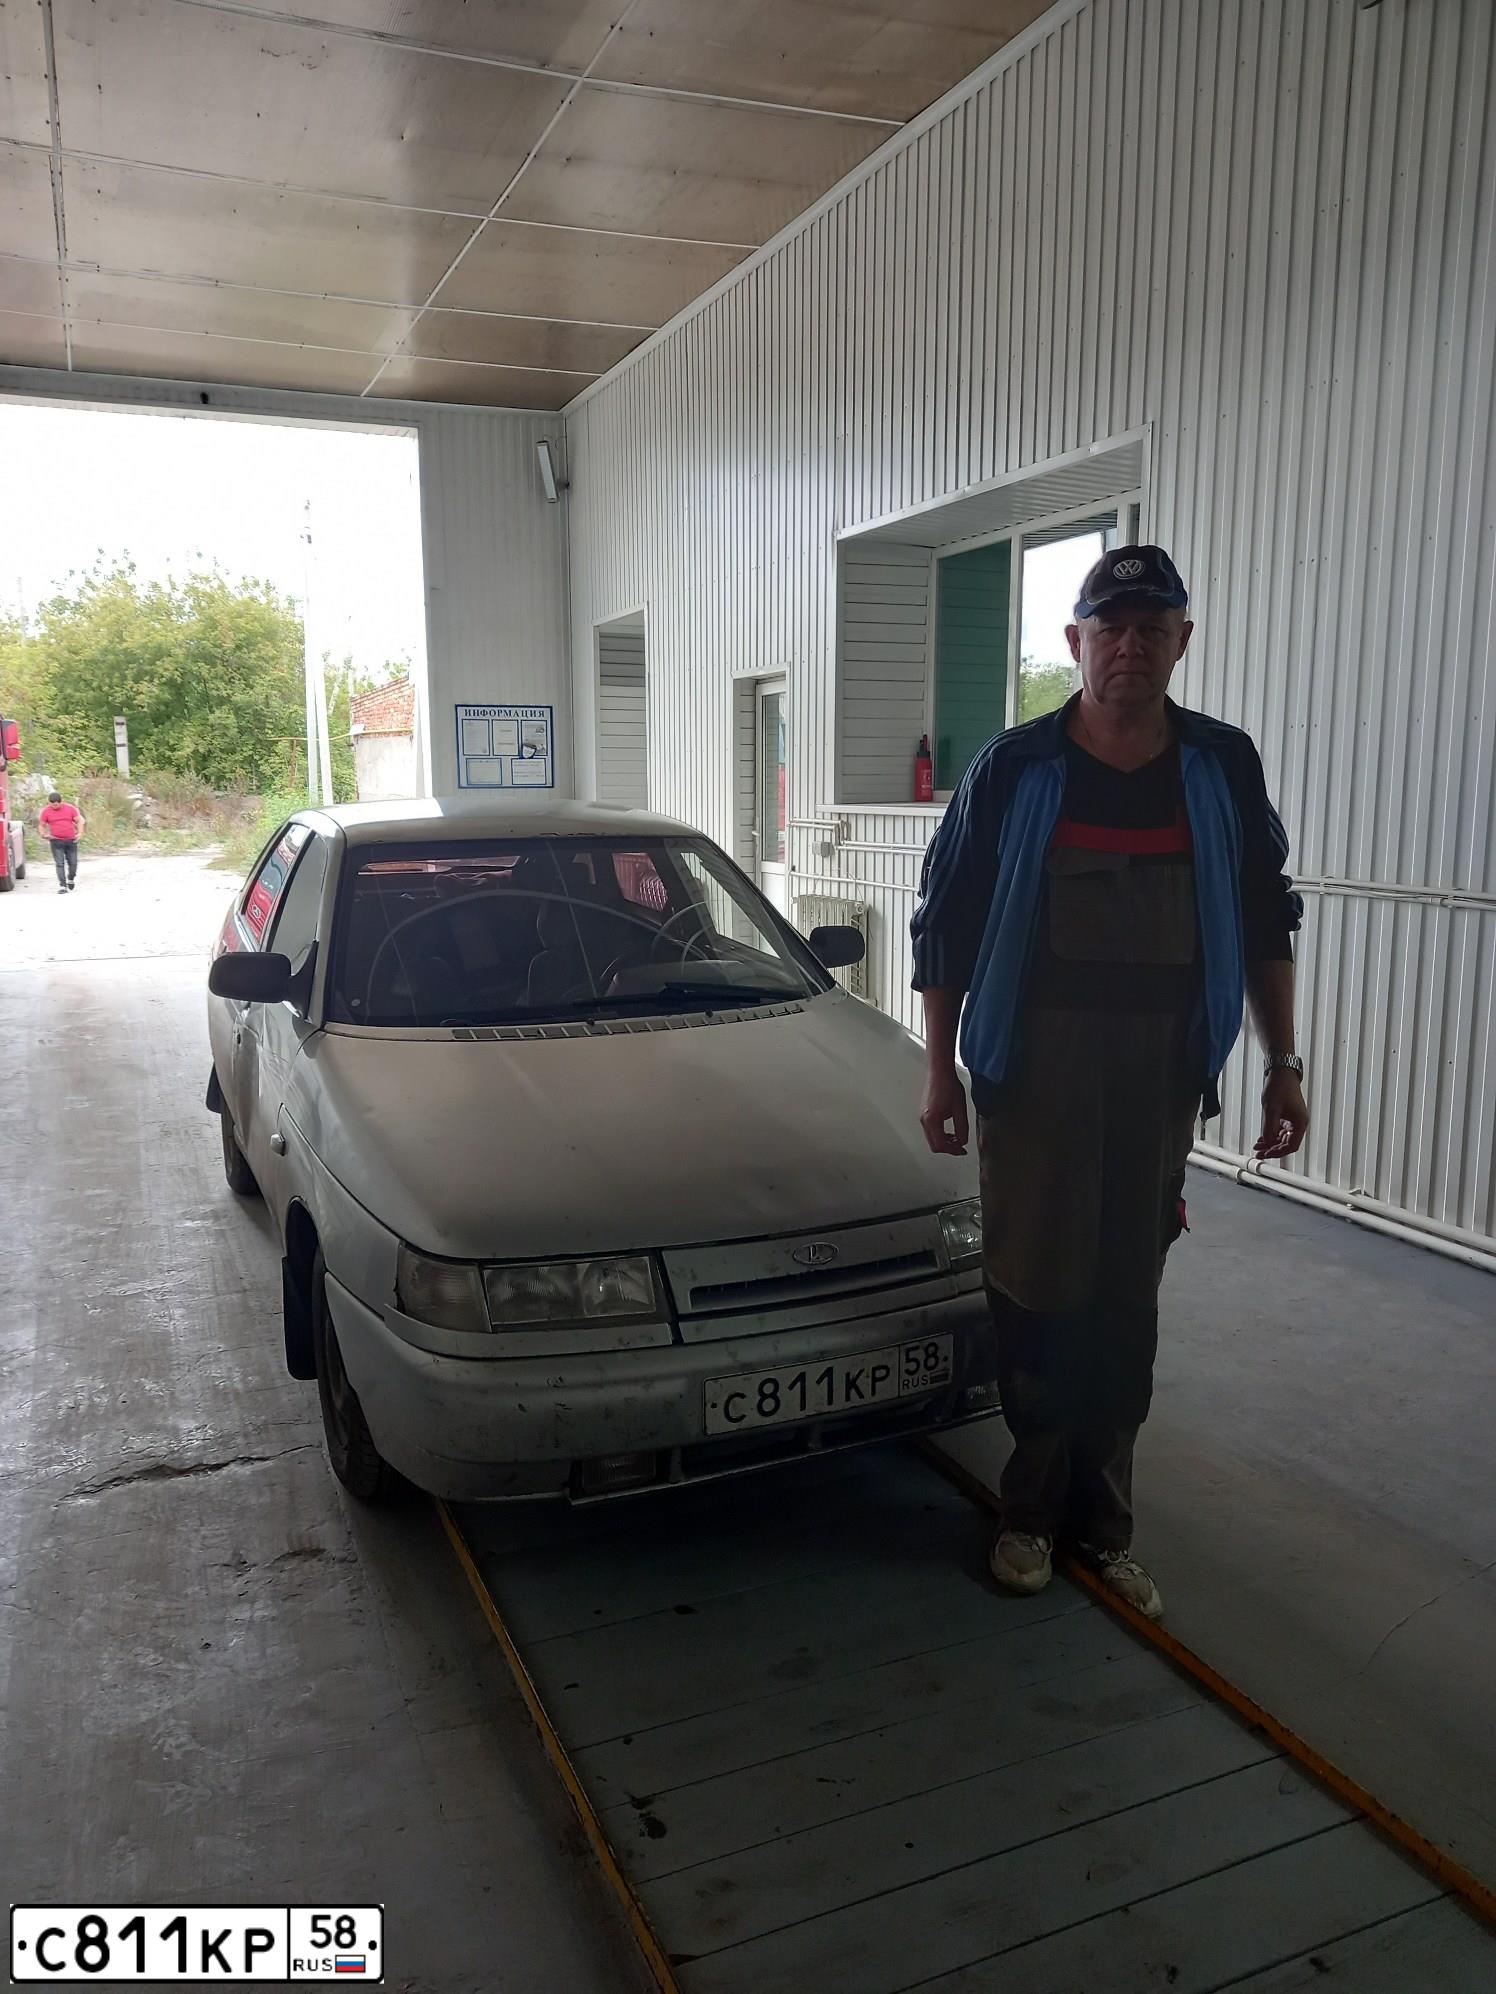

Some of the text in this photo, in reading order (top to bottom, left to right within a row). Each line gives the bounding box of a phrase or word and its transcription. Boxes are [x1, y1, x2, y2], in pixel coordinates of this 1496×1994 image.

[464, 708, 545, 718] ИНФОРМАЦИЯ
[904, 1341, 940, 1376] 58
[902, 1374, 929, 1391] RUS
